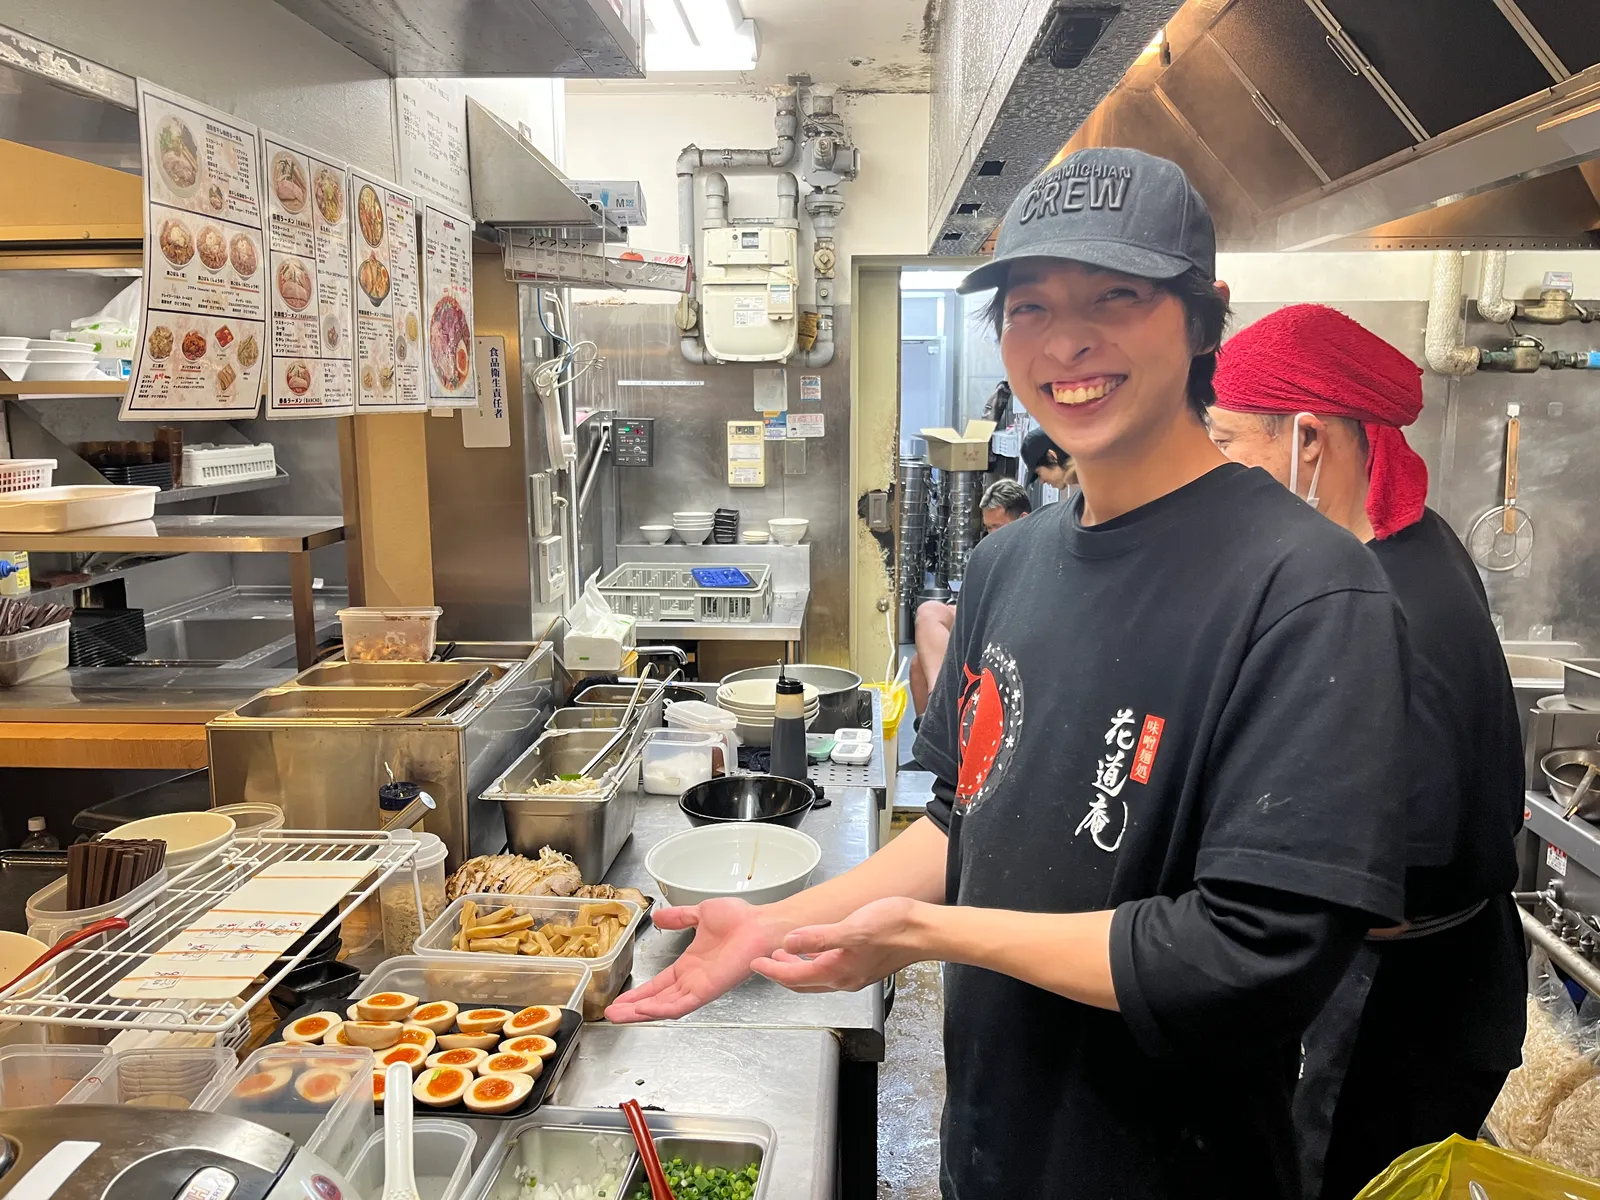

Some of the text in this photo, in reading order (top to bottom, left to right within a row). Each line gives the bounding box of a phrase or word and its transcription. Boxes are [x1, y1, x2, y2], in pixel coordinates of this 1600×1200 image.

[616, 198, 625, 208] M
[1019, 178, 1130, 225] CREW
[489, 347, 503, 418] 食品衛生責任者
[1074, 708, 1136, 853] 花道庵
